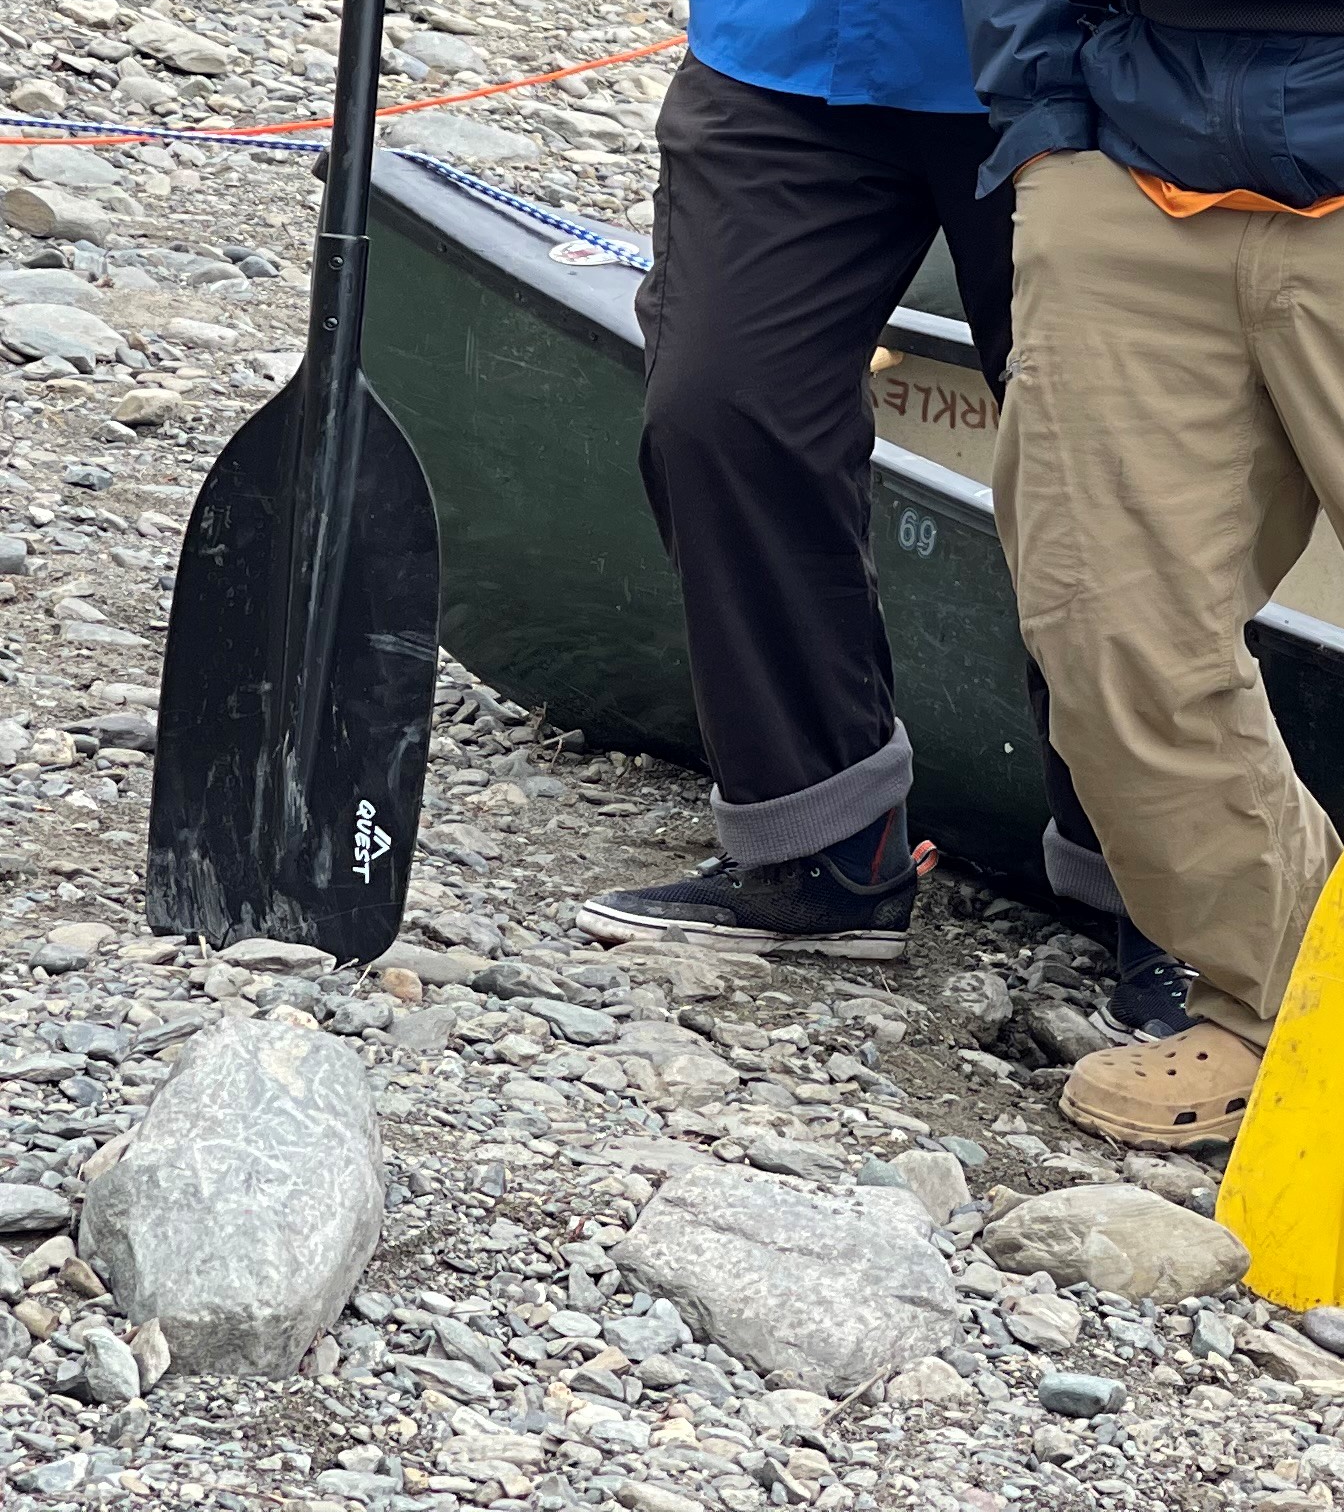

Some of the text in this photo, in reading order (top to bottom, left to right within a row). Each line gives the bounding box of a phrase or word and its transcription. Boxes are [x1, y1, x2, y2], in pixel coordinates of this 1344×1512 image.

[871, 377, 999, 430] RKLE
[898, 507, 938, 559] 69
[352, 799, 377, 884] QUEST
